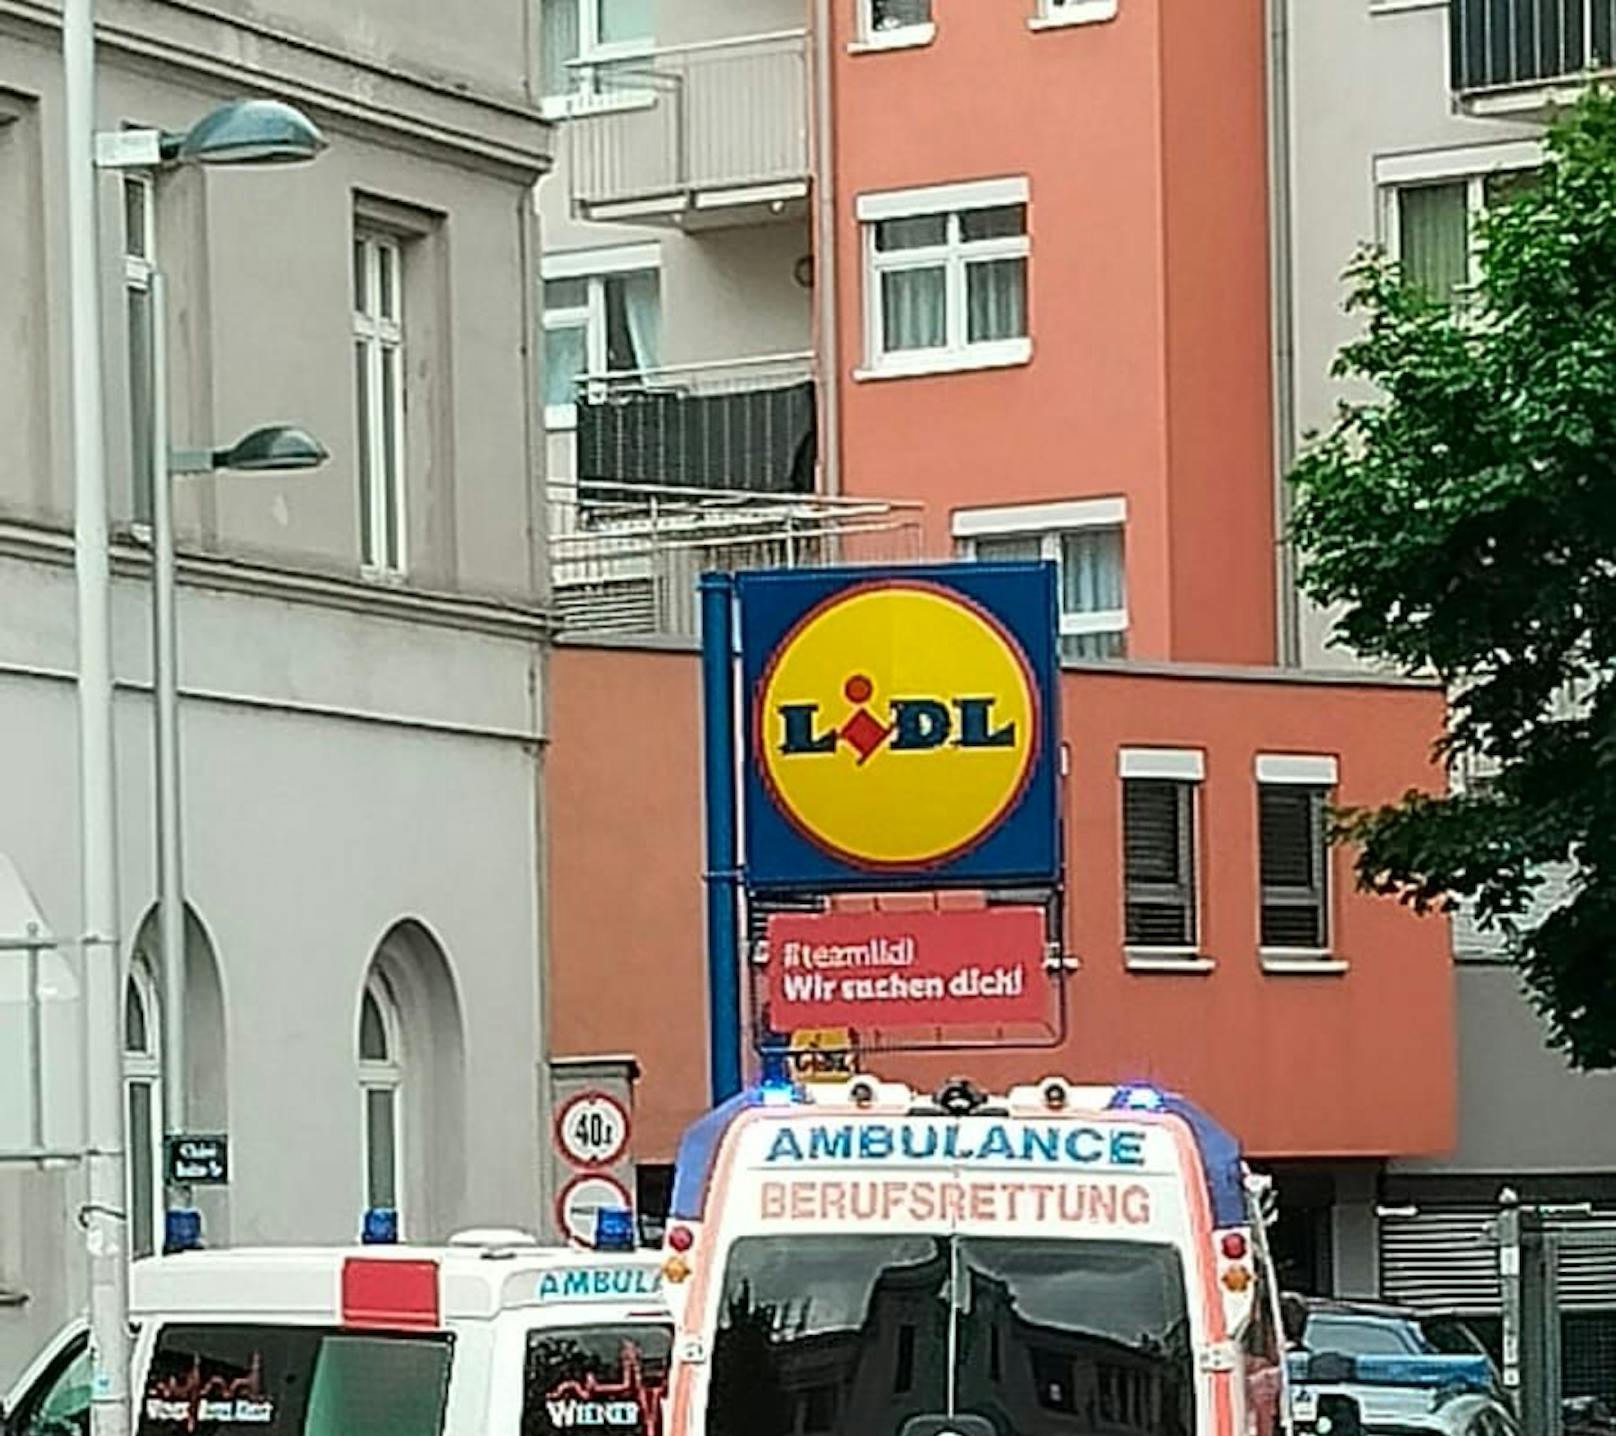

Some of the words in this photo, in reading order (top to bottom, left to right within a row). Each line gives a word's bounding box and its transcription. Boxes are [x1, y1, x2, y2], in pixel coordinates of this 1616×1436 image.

[777, 674, 1016, 766] LIDL
[784, 974, 836, 1001] Wir
[841, 975, 943, 1000] suchen
[949, 964, 1022, 997] dich!
[765, 1125, 1147, 1165] AMBULANCE
[760, 1182, 1151, 1224] BERUFSRETTUNG
